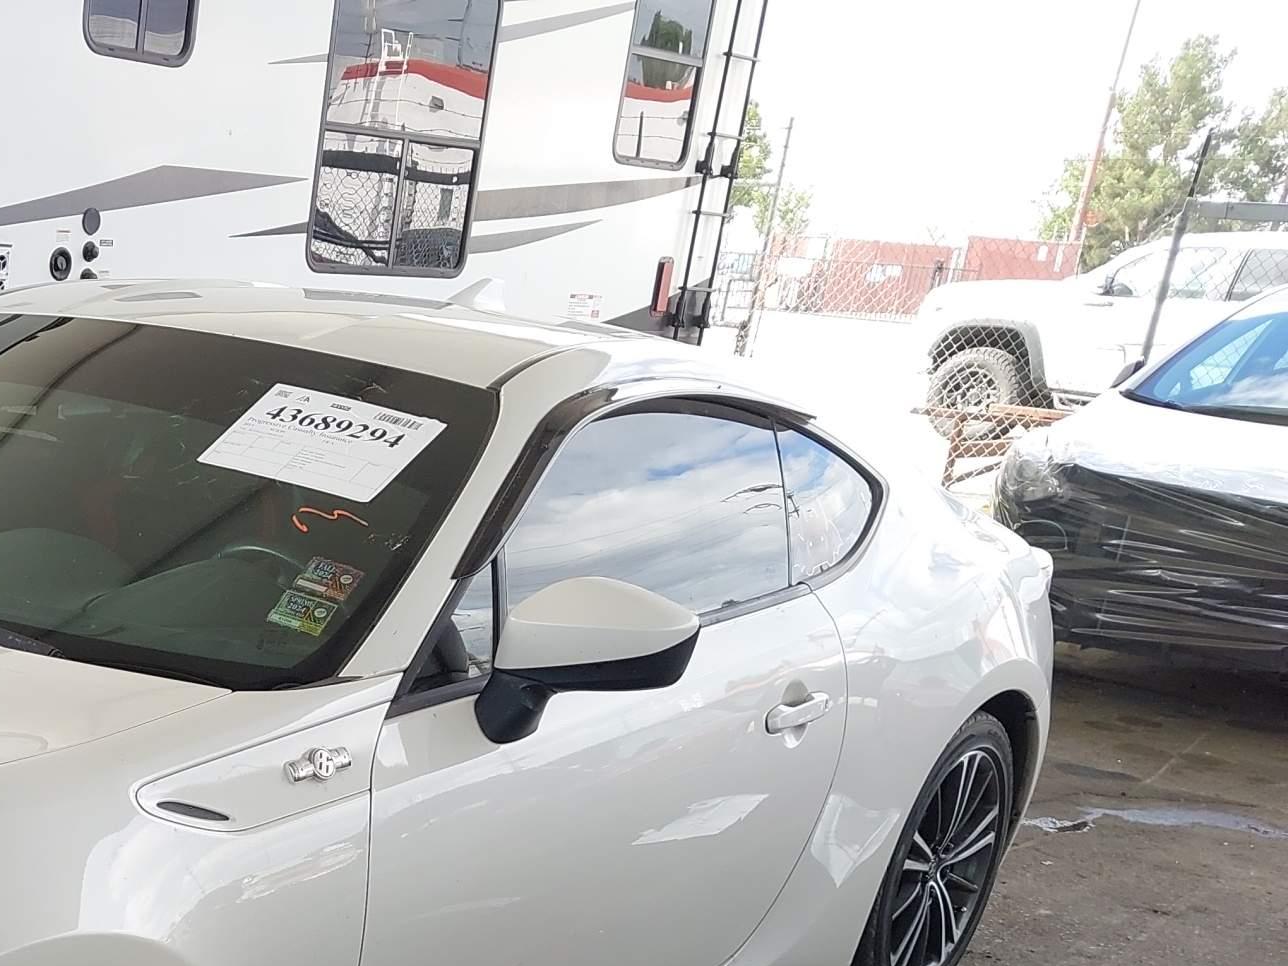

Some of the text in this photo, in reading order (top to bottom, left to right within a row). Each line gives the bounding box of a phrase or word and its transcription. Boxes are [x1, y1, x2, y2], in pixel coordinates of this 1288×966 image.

[247, 417, 288, 429] Progressive
[287, 424, 317, 437] Casualty
[319, 431, 353, 444] Insurance
[266, 406, 405, 448] 43689294
